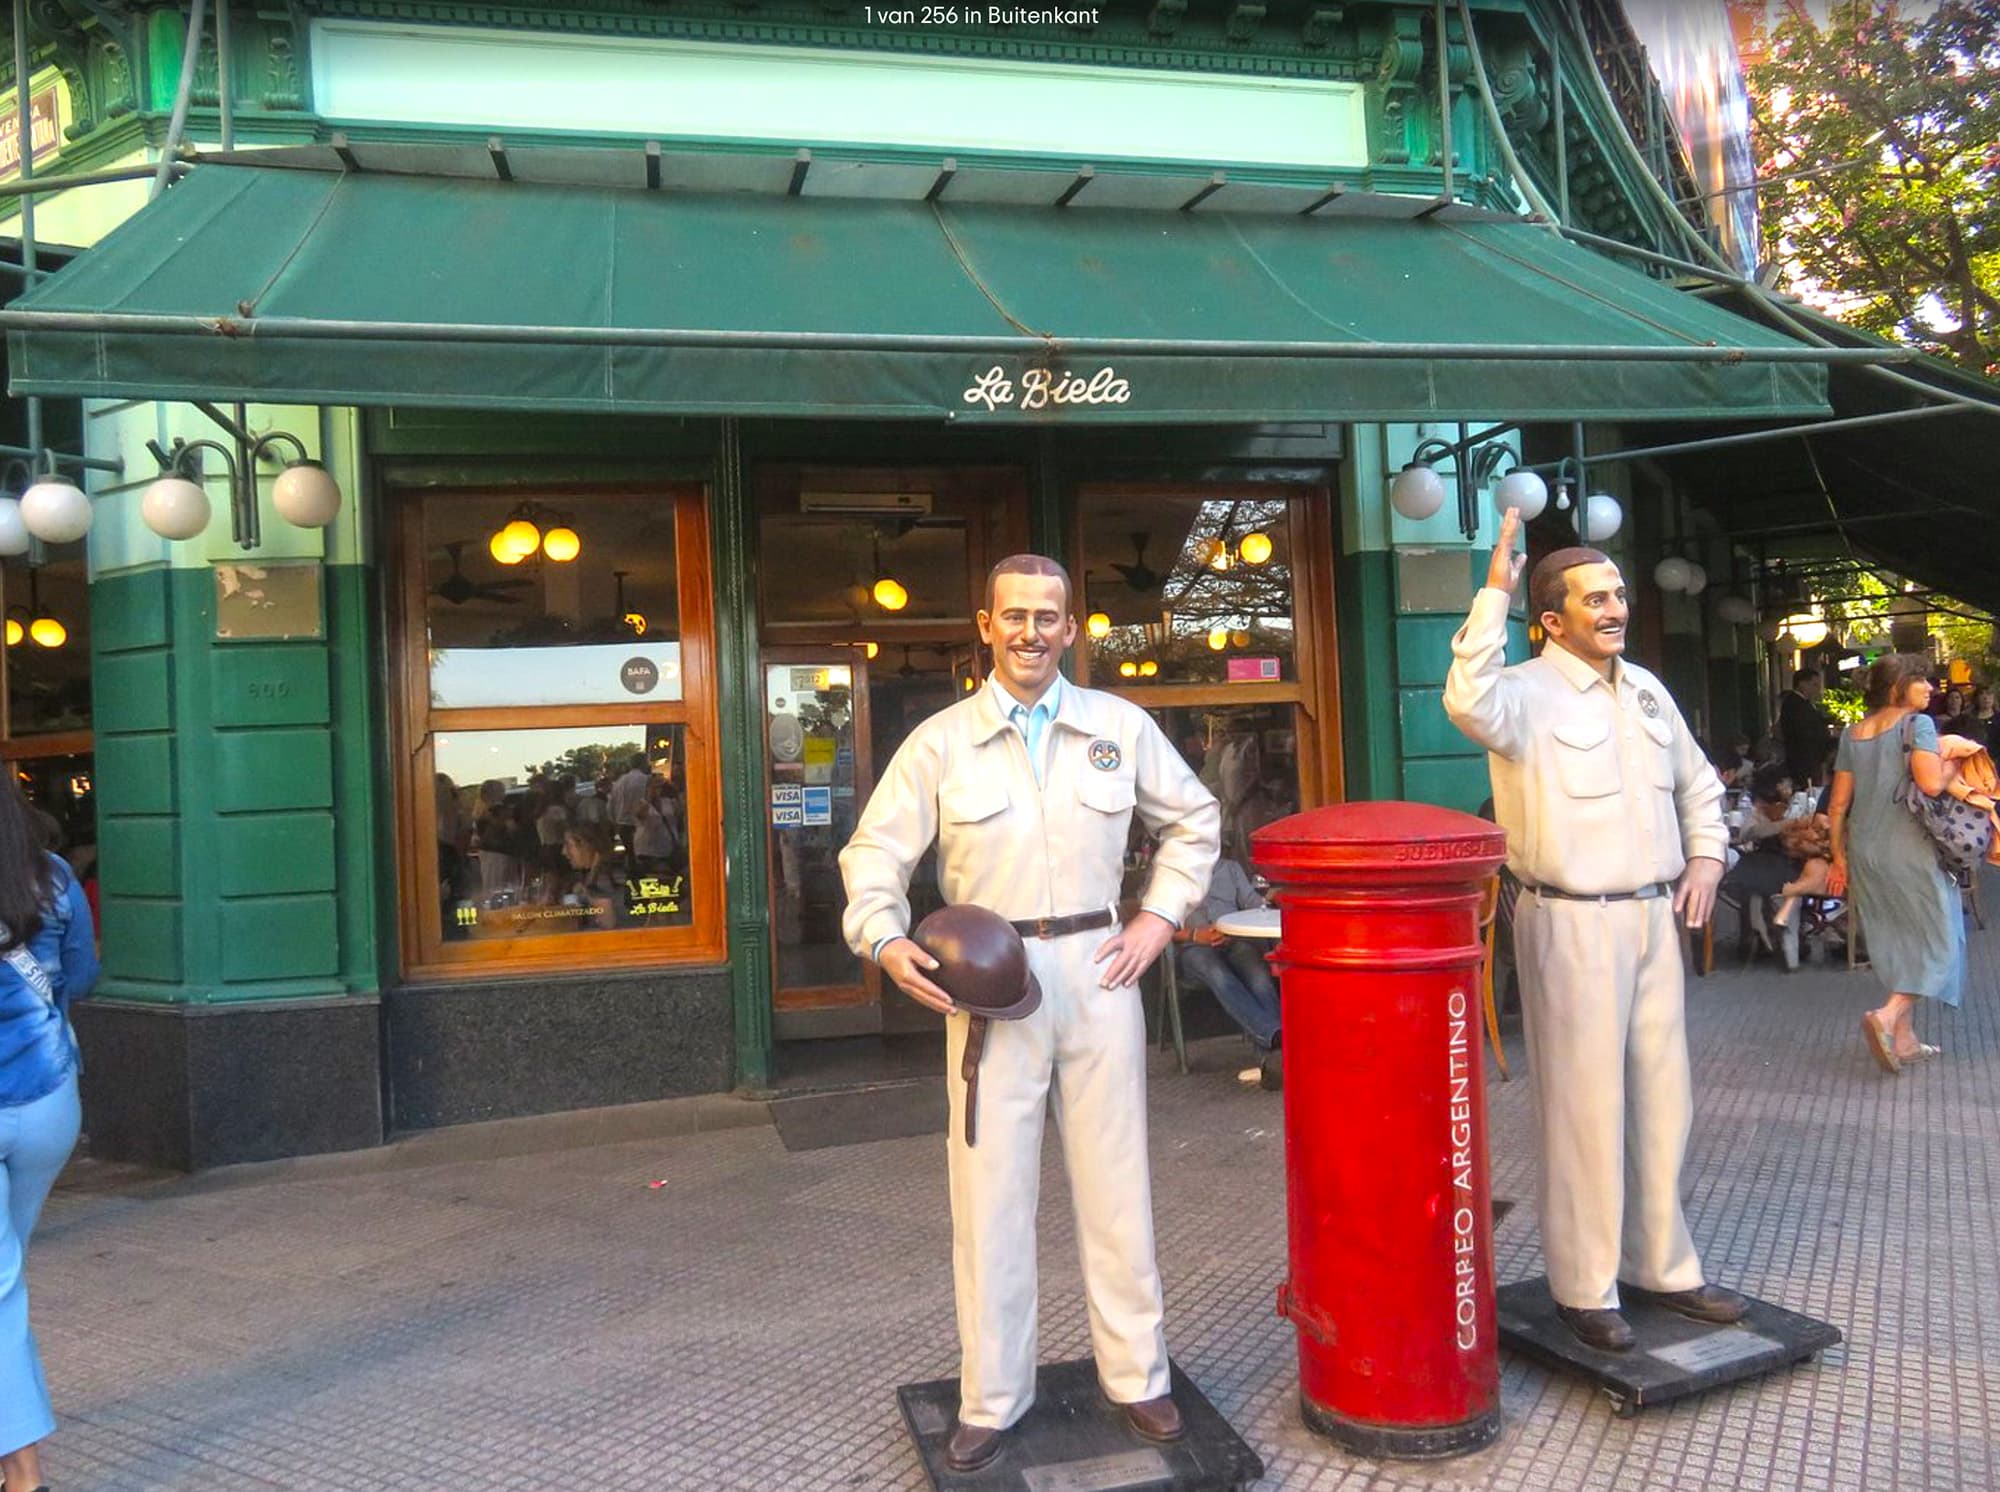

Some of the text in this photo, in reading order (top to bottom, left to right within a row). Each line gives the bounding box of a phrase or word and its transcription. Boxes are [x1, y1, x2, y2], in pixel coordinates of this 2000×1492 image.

[963, 365, 1131, 411] La Biela
[776, 791, 800, 801] VISA
[776, 811, 800, 821] VISA
[1448, 991, 1473, 1191] ARGENTINO
